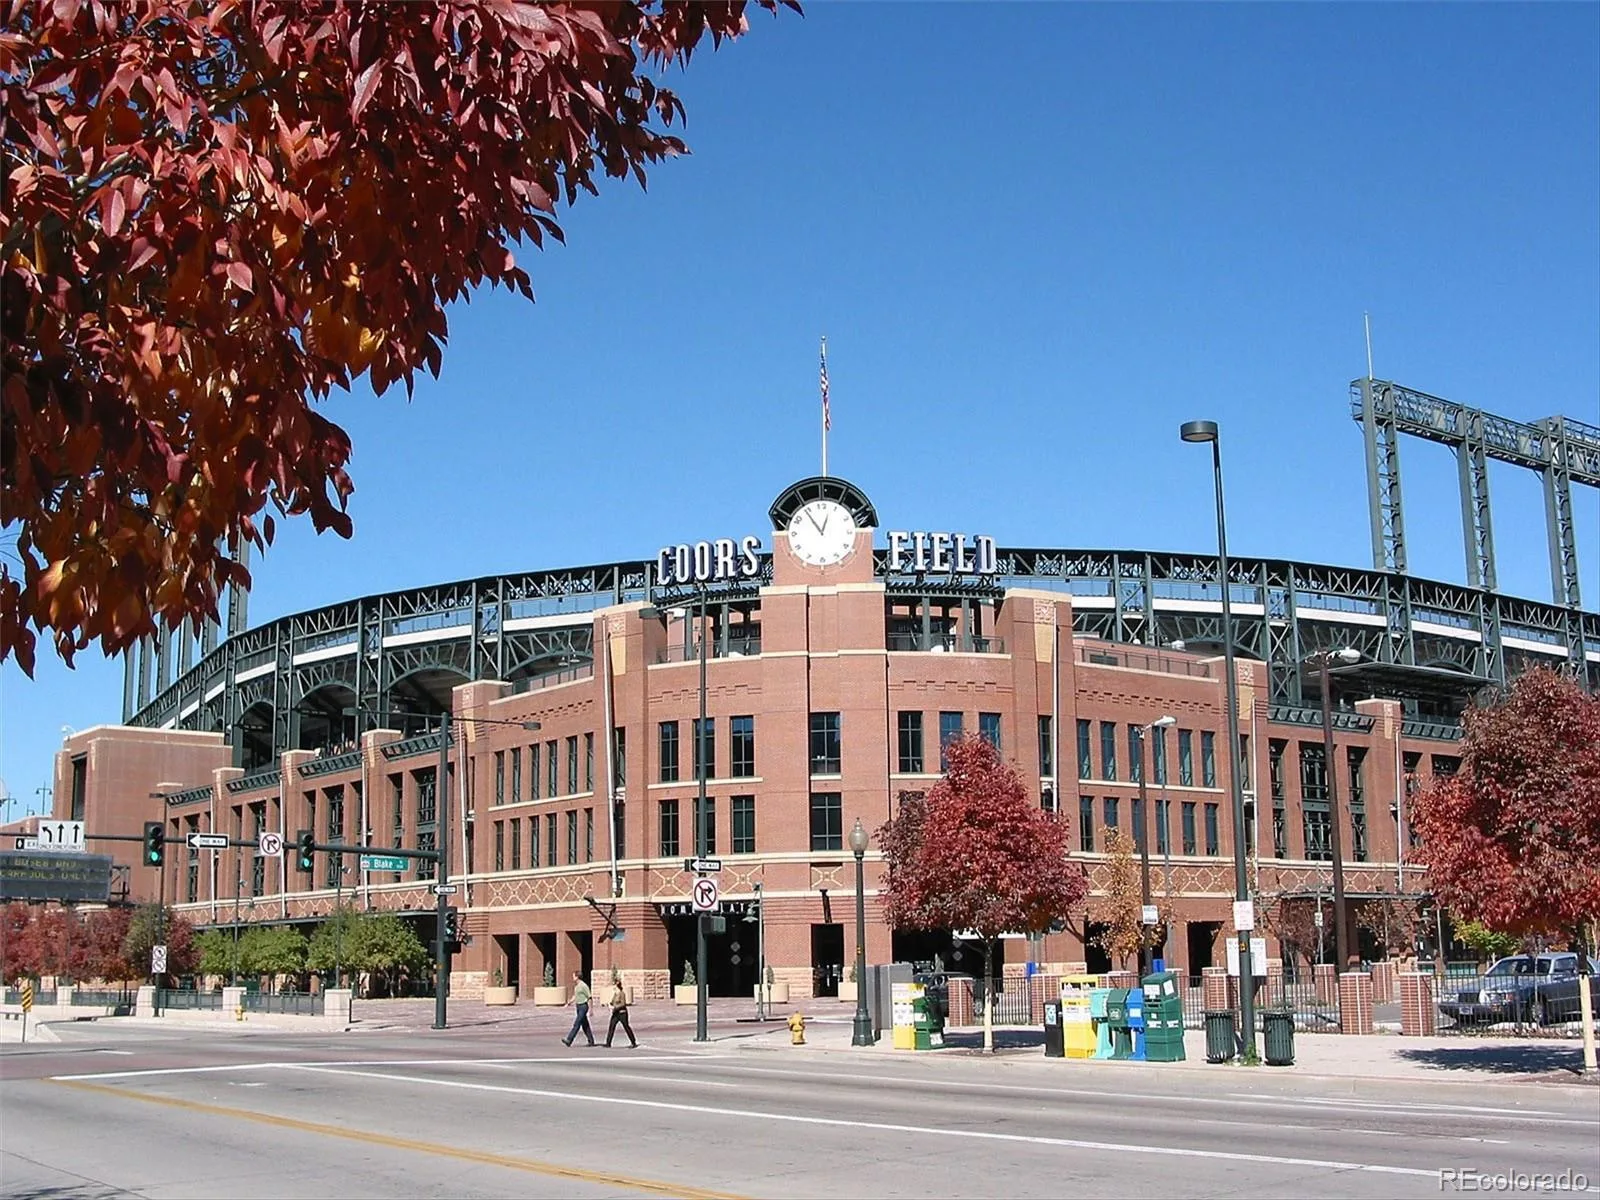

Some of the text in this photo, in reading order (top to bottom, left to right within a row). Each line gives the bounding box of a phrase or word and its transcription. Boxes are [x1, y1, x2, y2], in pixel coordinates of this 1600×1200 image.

[793, 515, 803, 525] 10
[658, 530, 998, 585] COORS FIELD
[374, 859, 393, 868] Blake
[660, 902, 696, 916] HOM
